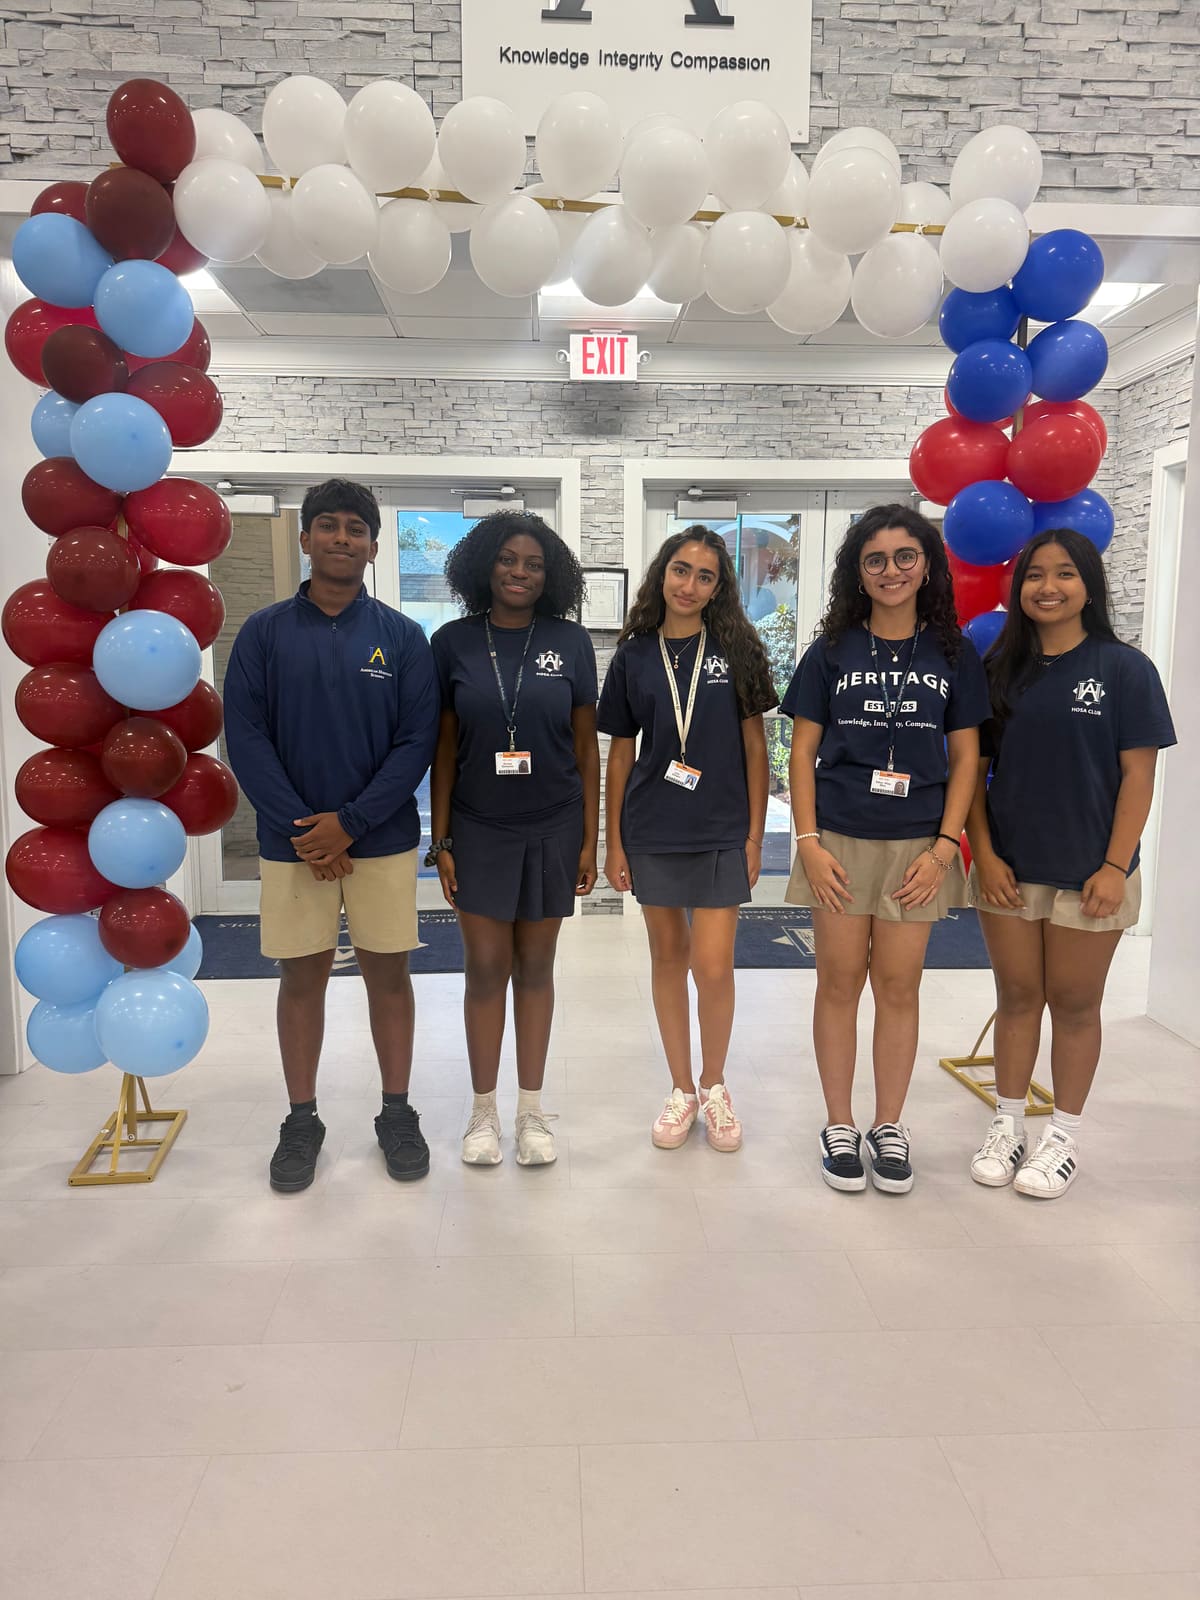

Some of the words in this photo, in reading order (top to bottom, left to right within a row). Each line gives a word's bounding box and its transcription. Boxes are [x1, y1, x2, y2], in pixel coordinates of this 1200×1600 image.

[499, 47, 589, 68] Knowledge
[599, 49, 663, 70] Integrity
[670, 51, 771, 72] Compassion
[582, 337, 629, 375] EXIT
[836, 671, 949, 699] HERITAGE
[890, 702, 914, 710] 165
